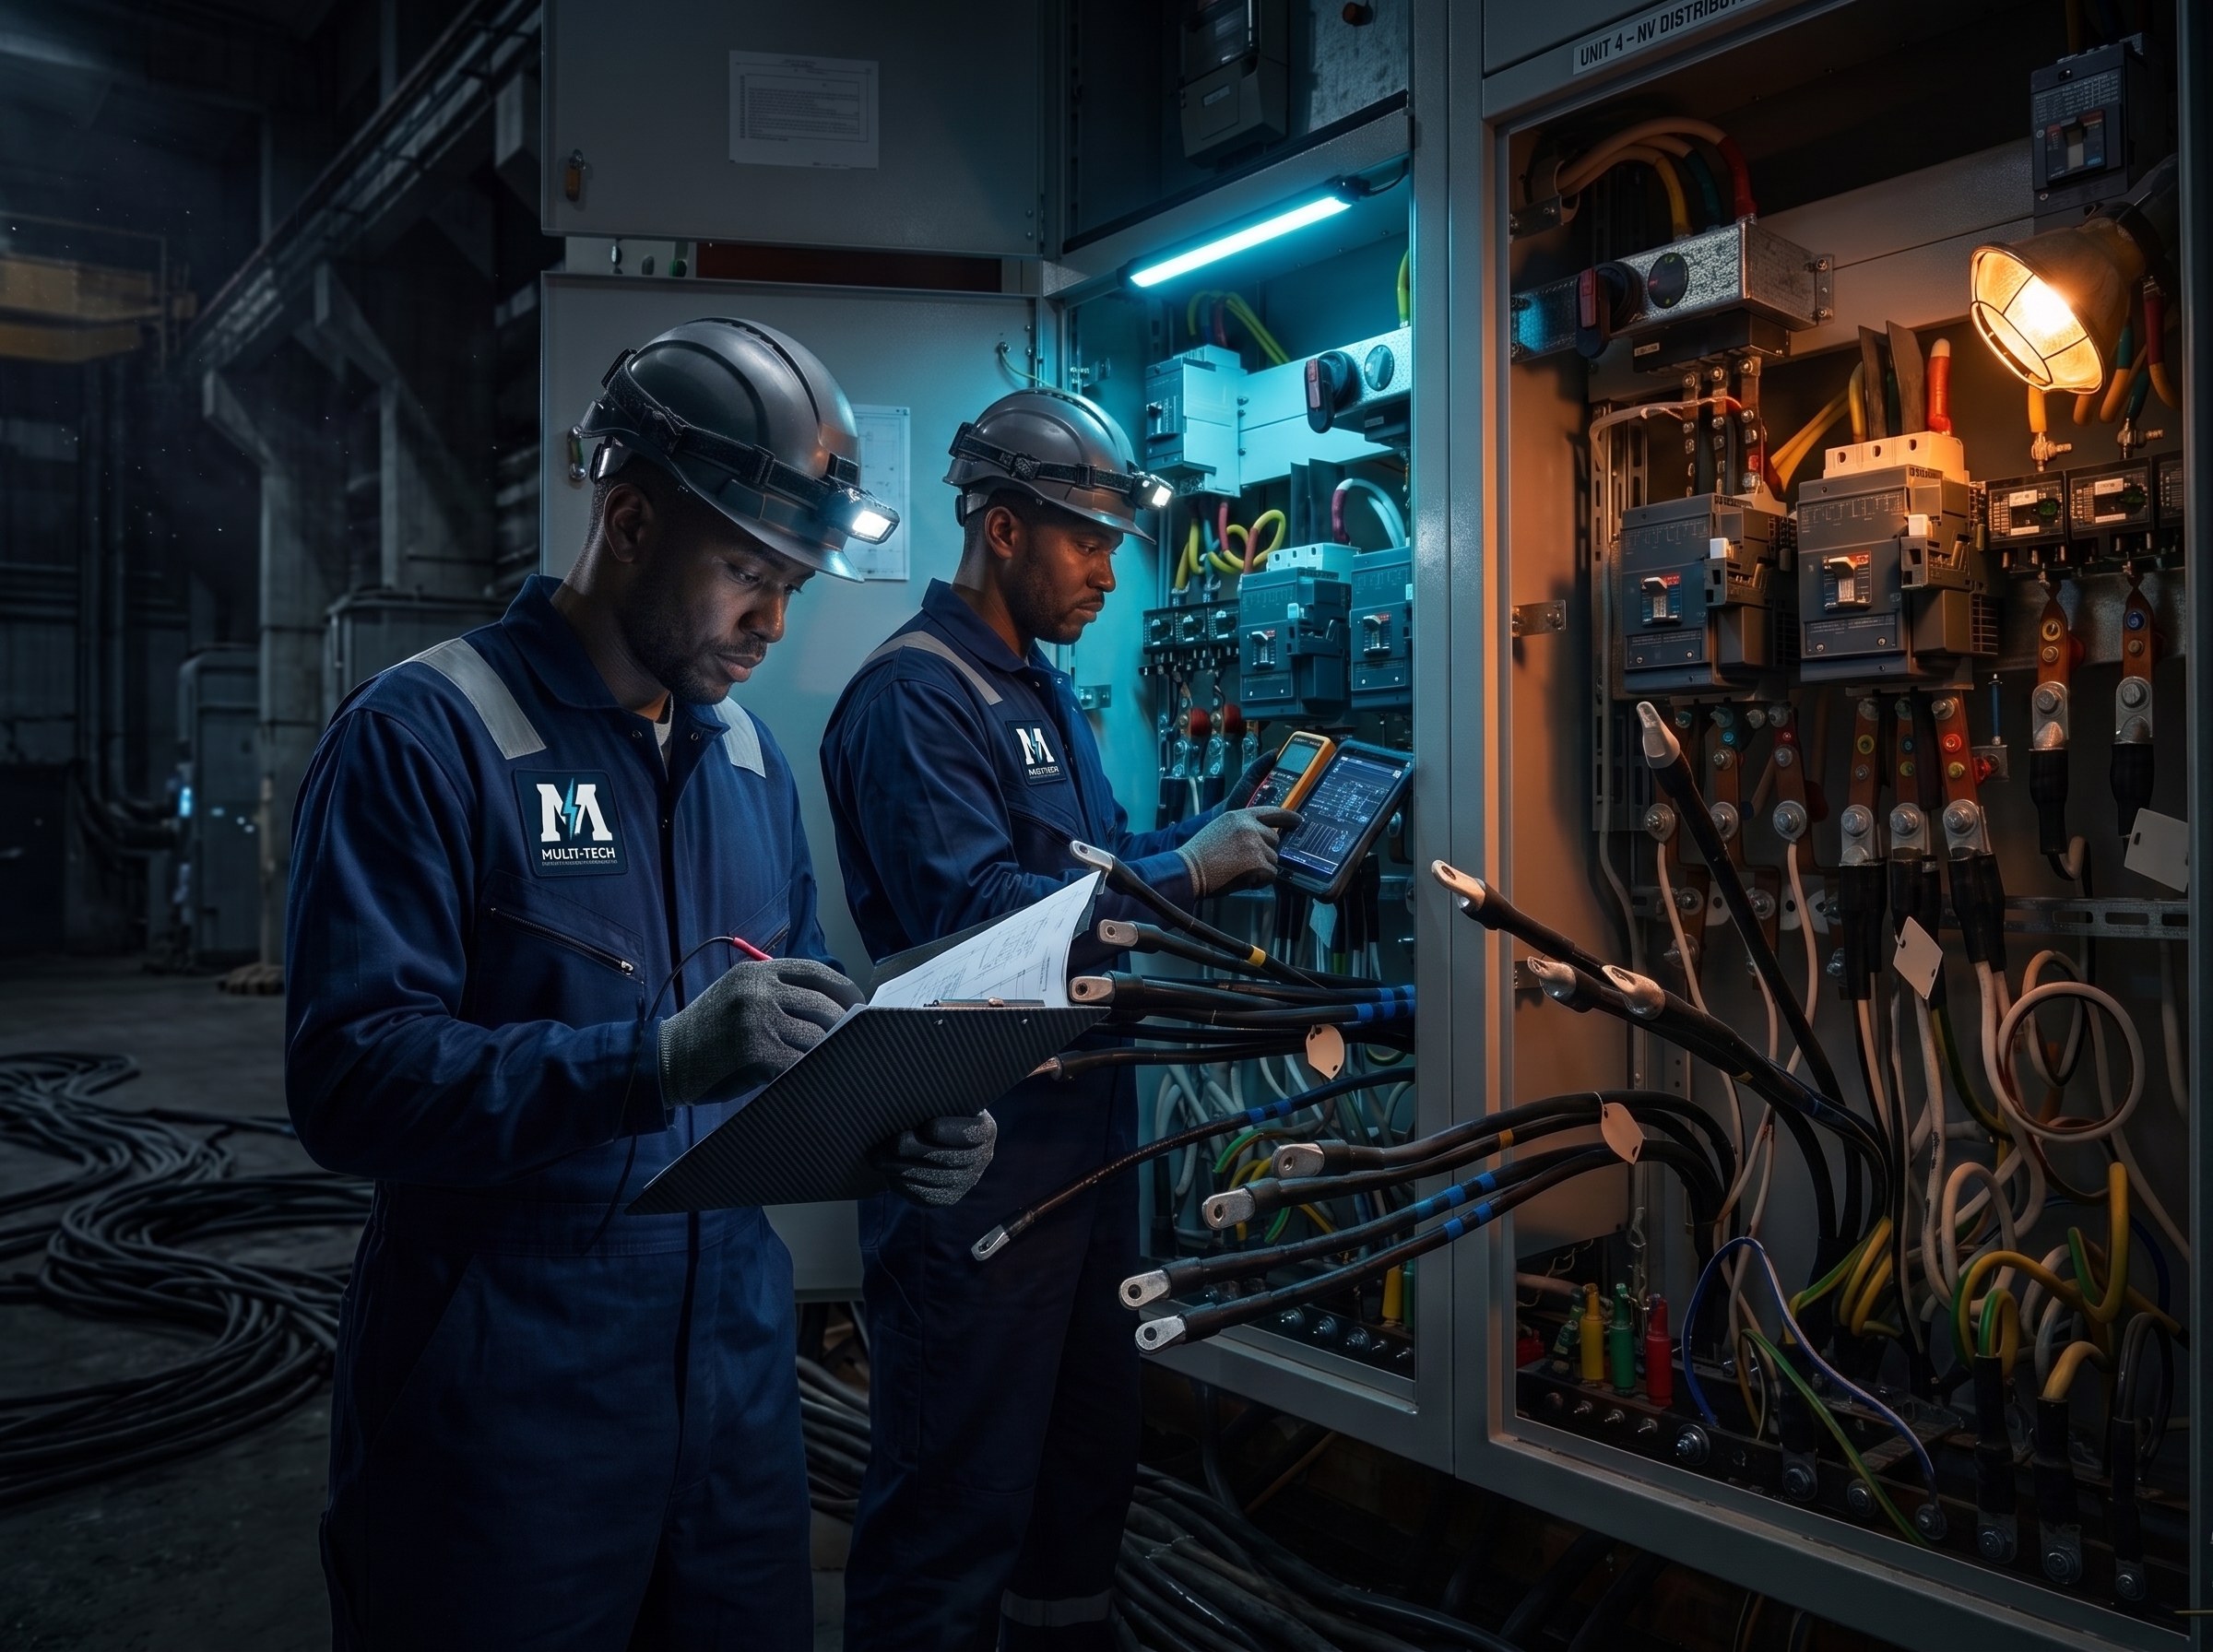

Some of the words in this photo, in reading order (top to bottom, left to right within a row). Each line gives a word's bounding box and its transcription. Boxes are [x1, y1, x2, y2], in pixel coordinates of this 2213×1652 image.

[1580, 38, 1612, 66] UNIT
[1615, 32, 1623, 52] 4
[1637, 18, 1657, 43] NV
[1660, 0, 1744, 34] DISTRIBU
[536, 783, 613, 843] M
